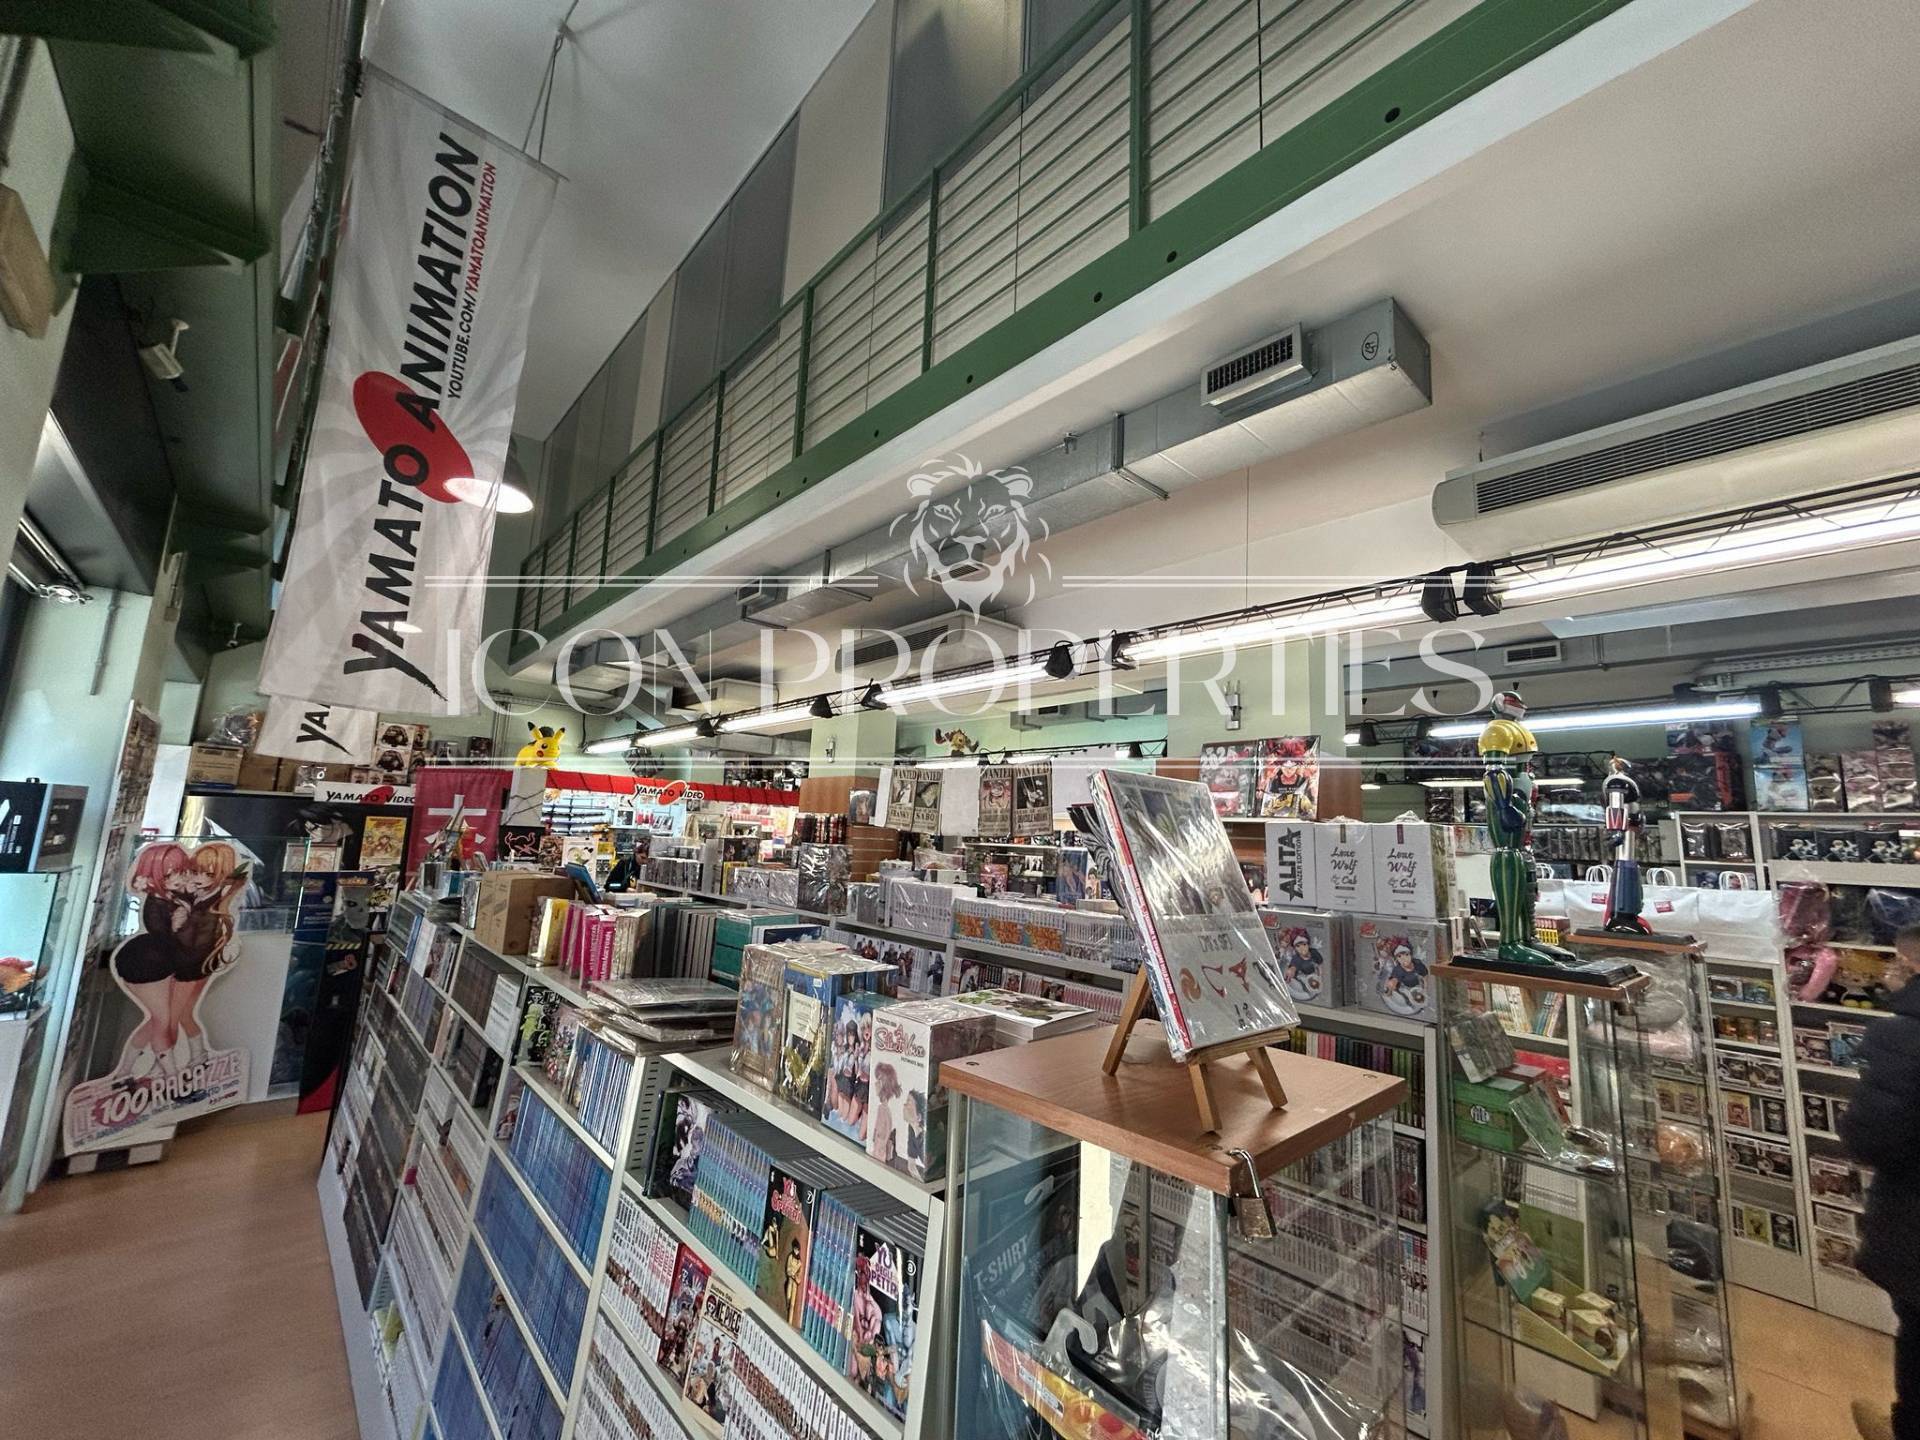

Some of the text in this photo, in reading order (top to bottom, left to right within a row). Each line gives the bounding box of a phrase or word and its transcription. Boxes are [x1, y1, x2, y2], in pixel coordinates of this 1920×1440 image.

[447, 161, 497, 400] YOUTUBE.COM/YAMATOANIMATION
[343, 132, 480, 702] YAMATO ANIMATION
[296, 704, 352, 756] YA
[893, 769, 916, 780] WANTED
[917, 769, 942, 782] WANTED
[1014, 762, 1050, 778] WANTED
[326, 790, 380, 802] YAMATO
[632, 785, 704, 801] YAMATO VIDEO
[915, 811, 935, 821] SABO
[1330, 846, 1356, 858] Lone
[1387, 847, 1415, 860] Lone
[1278, 826, 1303, 902] ALITA
[1330, 858, 1359, 875] Wolf
[1387, 860, 1418, 878] Wolf
[1341, 875, 1358, 886] Cub
[1399, 877, 1417, 889] Cub
[100, 1086, 150, 1124] 100
[150, 1054, 241, 1106] RAGAZZE
[973, 1234, 1029, 1287] T-SHIRT
